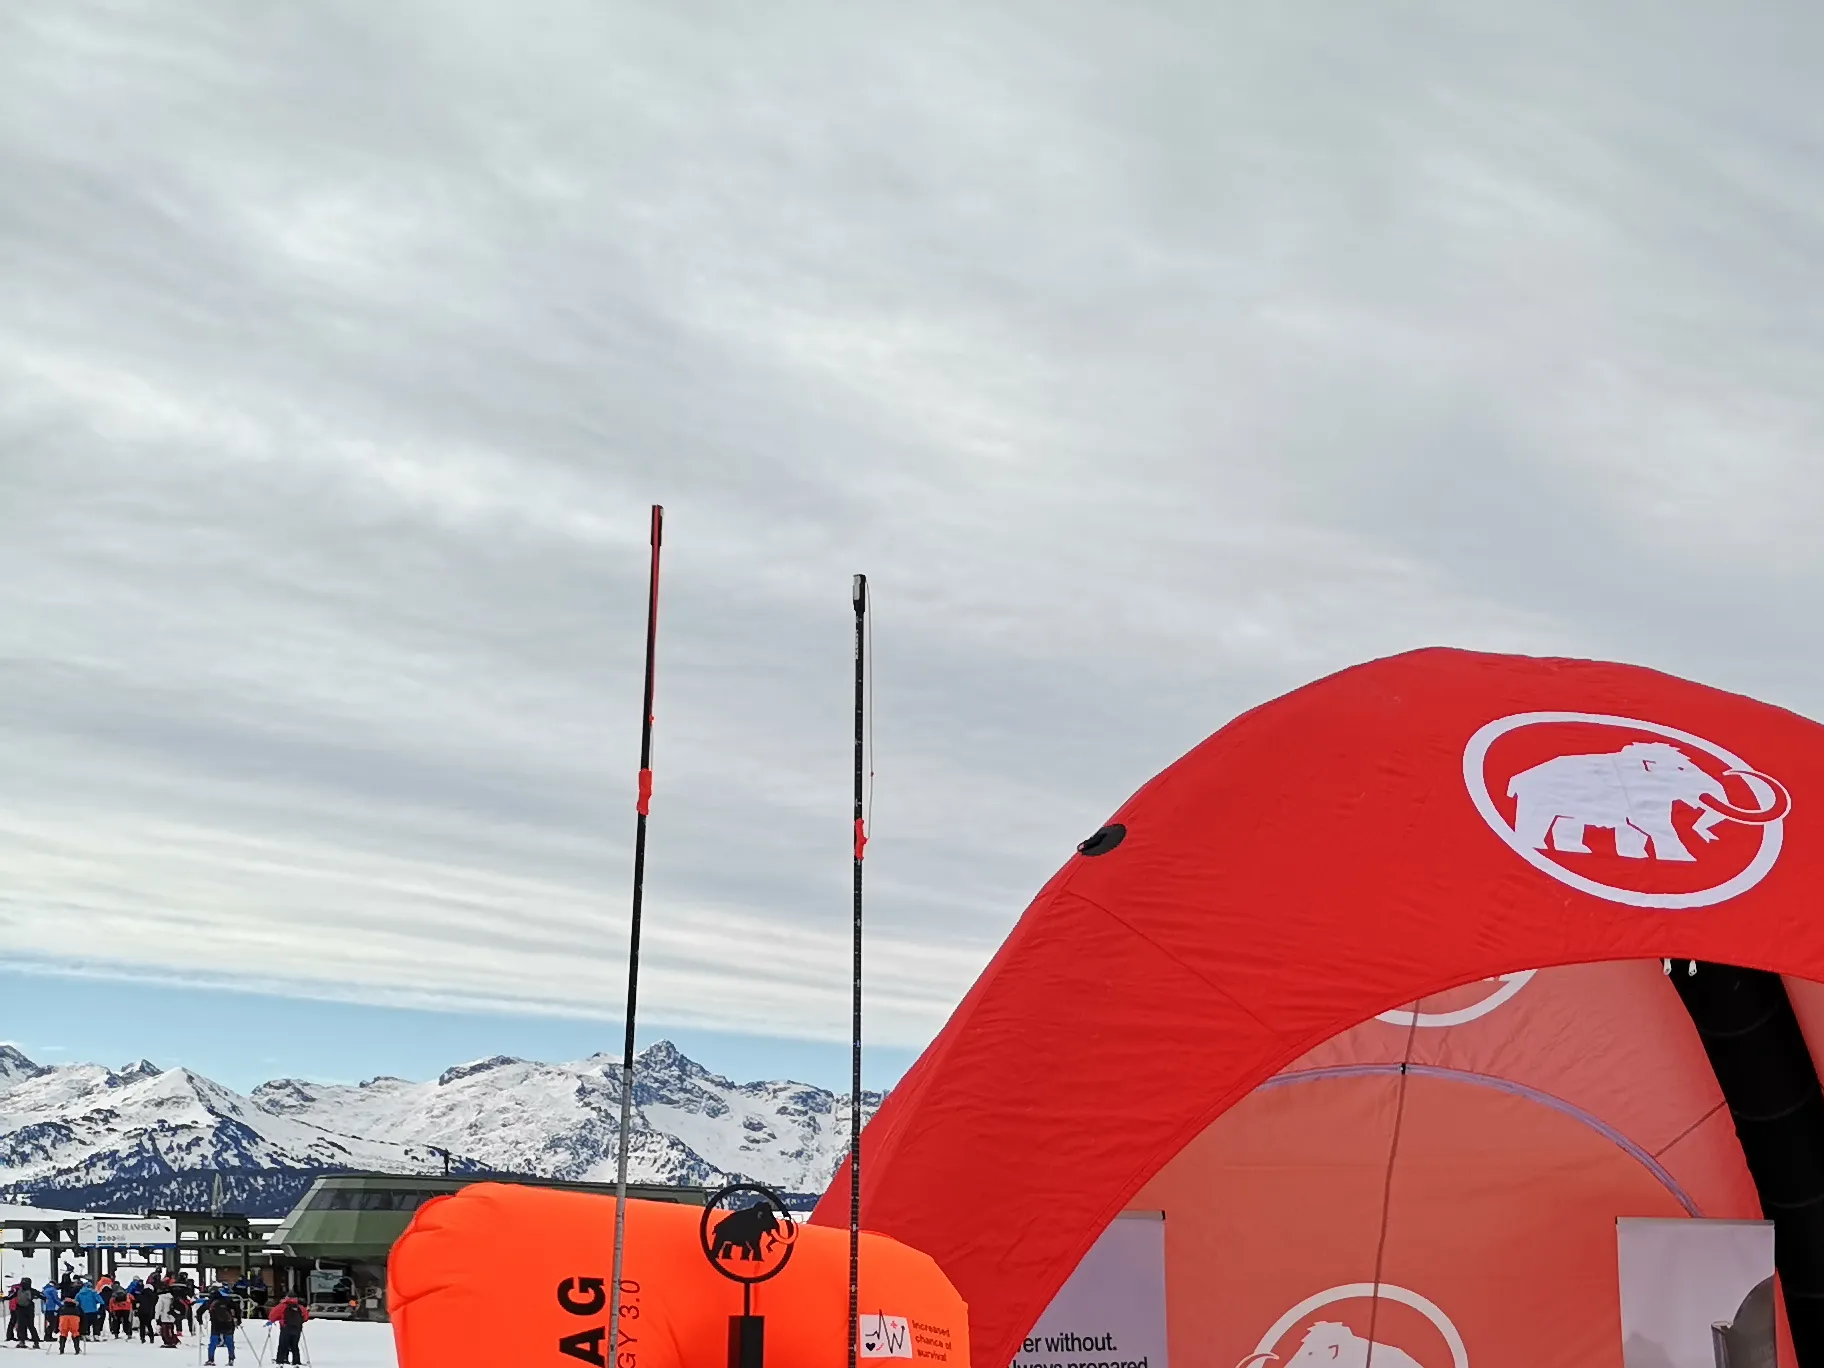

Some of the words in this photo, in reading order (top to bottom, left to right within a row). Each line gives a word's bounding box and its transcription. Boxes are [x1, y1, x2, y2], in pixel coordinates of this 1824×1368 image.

[915, 1334, 943, 1348] chance
[1045, 1332, 1118, 1352] without.
[917, 1349, 946, 1362] survival
